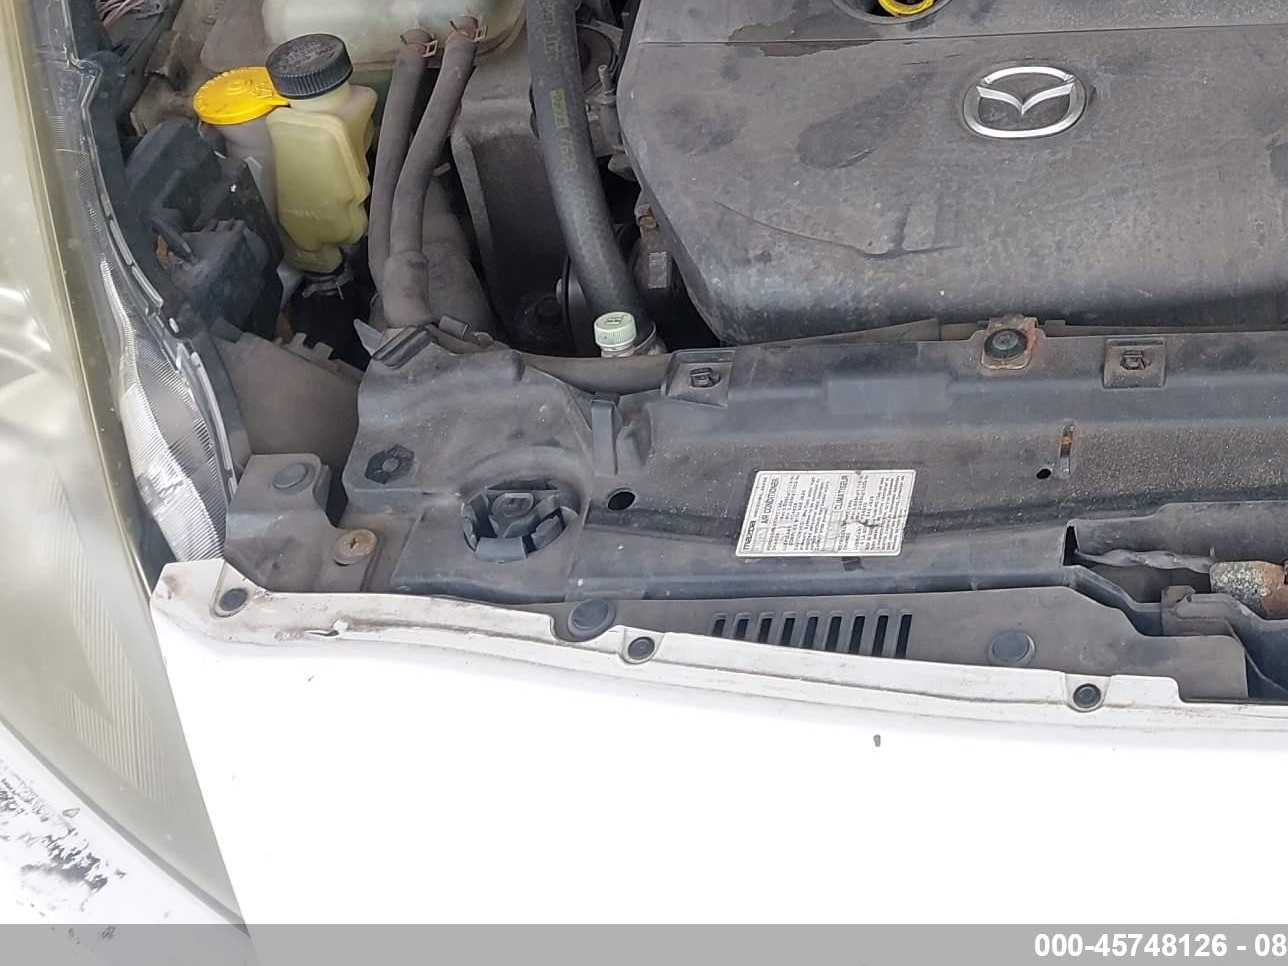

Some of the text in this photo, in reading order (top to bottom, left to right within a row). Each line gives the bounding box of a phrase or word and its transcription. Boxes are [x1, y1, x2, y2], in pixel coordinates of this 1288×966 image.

[764, 477, 780, 514] CONDITIONER
[834, 474, 849, 511] CLIMATISEUR
[743, 521, 757, 550] mazda
